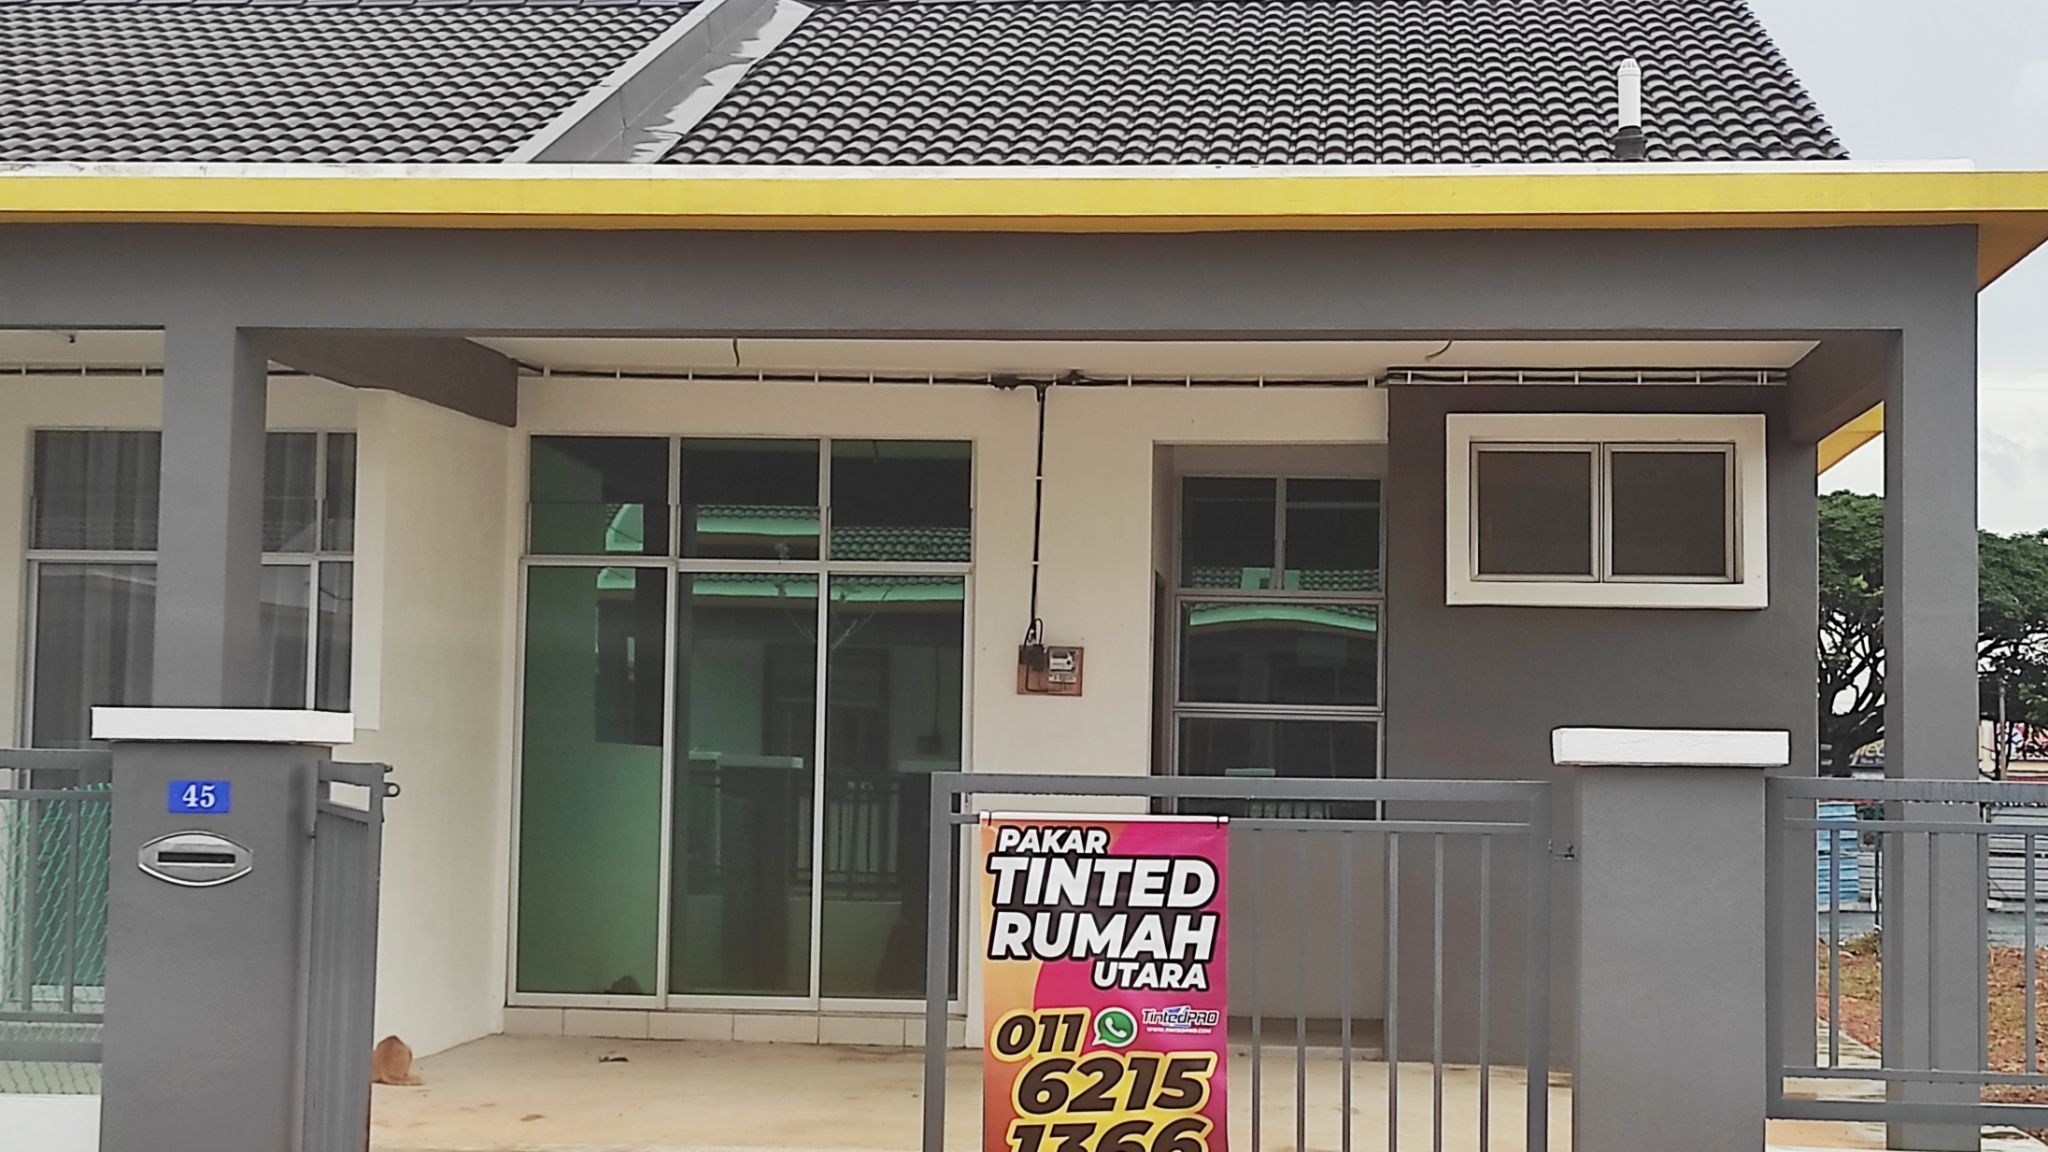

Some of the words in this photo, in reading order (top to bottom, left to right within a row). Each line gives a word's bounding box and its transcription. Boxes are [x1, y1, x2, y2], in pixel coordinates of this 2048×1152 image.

[181, 783, 216, 808] 45
[998, 828, 1108, 854] PAKAR
[989, 856, 1217, 908] TINTED
[990, 911, 1218, 960] RUMAH
[1094, 961, 1207, 989] UTARA
[996, 1013, 1085, 1055] 011
[1017, 1056, 1211, 1115] 6215
